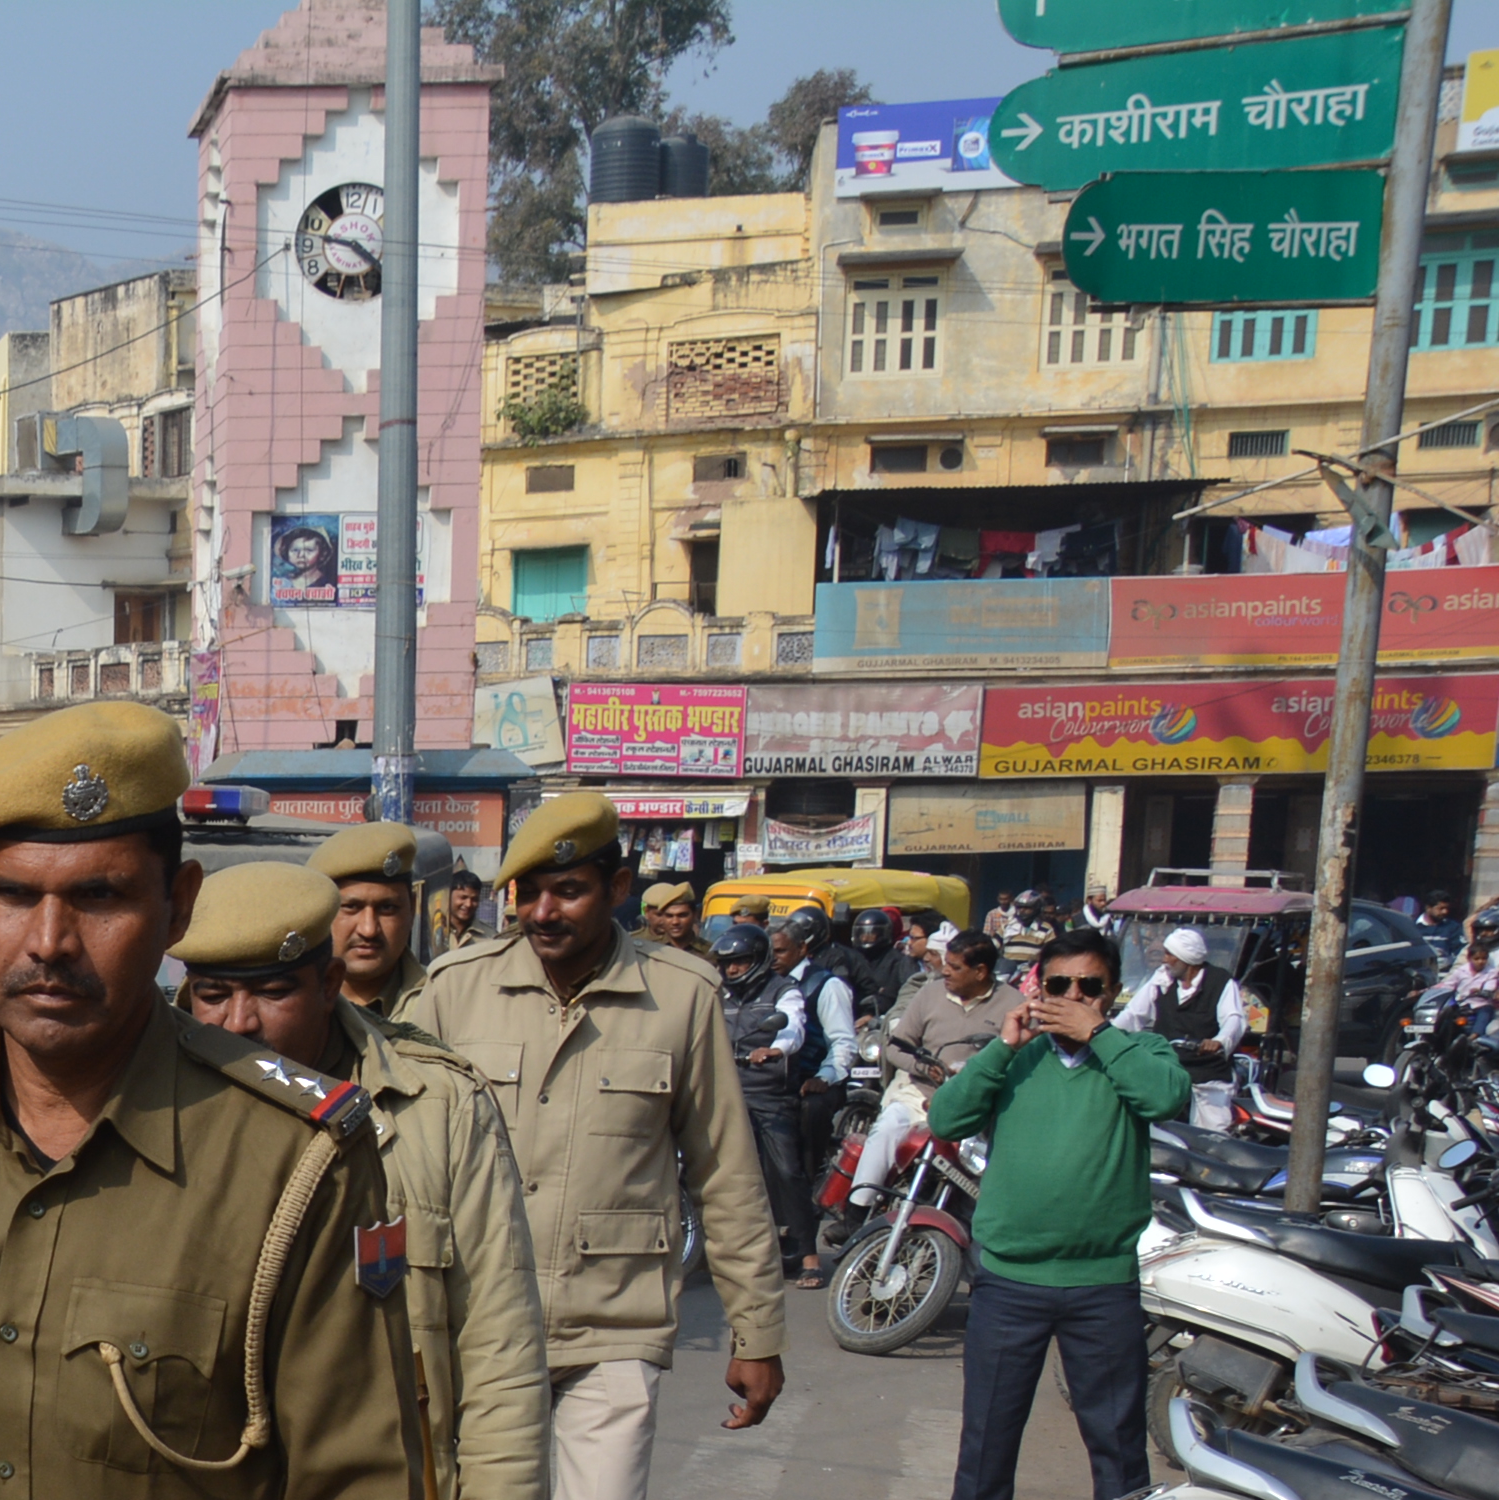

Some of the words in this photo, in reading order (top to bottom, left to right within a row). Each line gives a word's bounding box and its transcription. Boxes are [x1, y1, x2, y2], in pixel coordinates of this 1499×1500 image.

[1056, 92, 1221, 150] काशीराम
[1241, 78, 1371, 135] चौराहा
[346, 191, 362, 209] 12
[304, 213, 323, 232] 10
[1117, 219, 1183, 261] भगत
[1267, 207, 1361, 262] चौराहा
[302, 237, 314, 254] 9
[307, 259, 320, 276] 8
[1183, 595, 1322, 626] asianpaints
[921, 656, 978, 666] GHASIRAM
[571, 696, 630, 731] महावीर
[633, 703, 684, 741] पुस्तक
[687, 704, 742, 734] भण्डार
[1017, 693, 1162, 725] asianpaints
[1050, 705, 1173, 742] Colourworld
[743, 757, 827, 774] GUJARMAL
[832, 755, 916, 773] GHASIRAM
[922, 755, 974, 765] ALWAR
[993, 758, 1125, 774] GUJARMAL
[1131, 756, 1261, 771] GHASIRAM
[273, 799, 336, 815] यातायात
[338, 797, 366, 822] पुलि
[638, 801, 682, 814] भण्डार
[438, 821, 480, 832] BOOTH
[904, 844, 973, 852] GUJARMAL
[998, 840, 1066, 850] GHASIRAM
